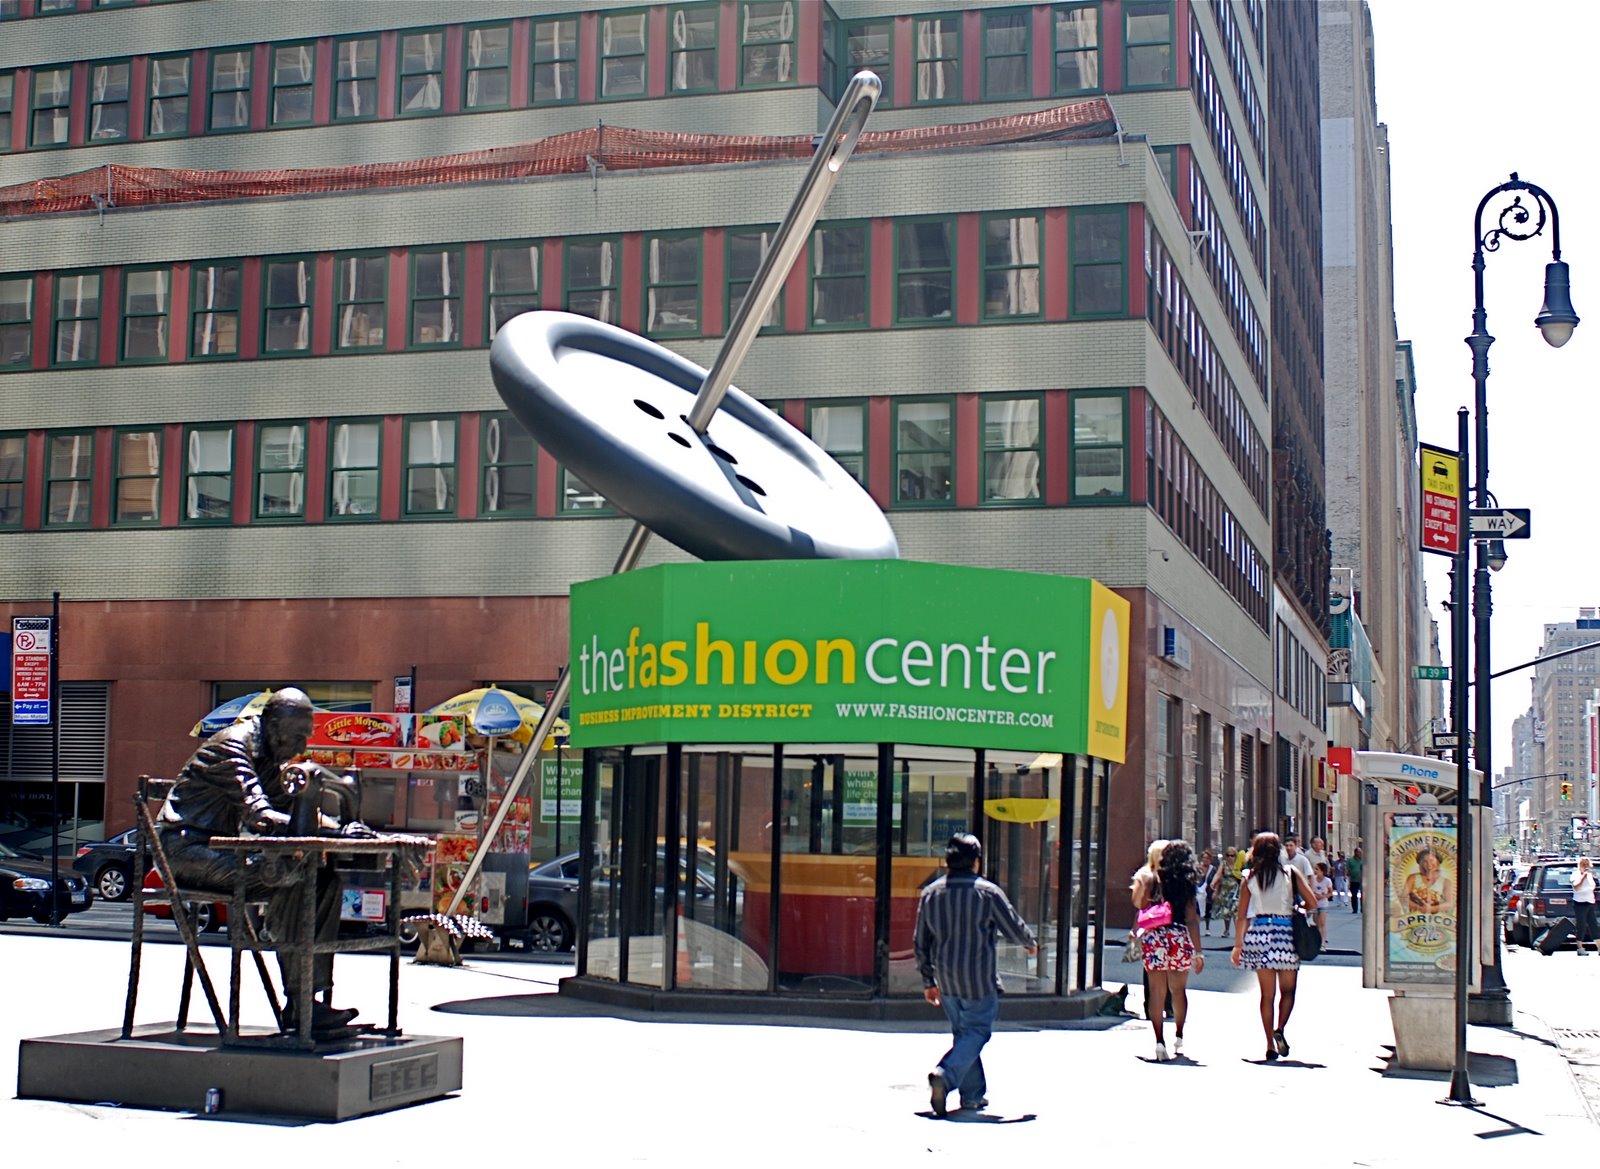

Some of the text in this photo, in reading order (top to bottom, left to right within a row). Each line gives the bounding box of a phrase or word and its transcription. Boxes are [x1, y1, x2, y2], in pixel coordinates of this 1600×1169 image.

[1426, 494, 1456, 510] NO STANDING
[1487, 518, 1516, 530] WAY
[1419, 668, 1427, 678] W
[1428, 668, 1440, 678] 39
[580, 708, 619, 726] BUSINESS
[718, 704, 812, 718] DISTRICT
[836, 703, 1054, 728] WWW.FASHIONCENTER.COM
[328, 718, 352, 732] Little
[1401, 763, 1438, 779] Phone
[847, 779, 873, 788] when
[1391, 834, 1458, 859] SUMMERTIM
[1397, 915, 1457, 928] APRICO
